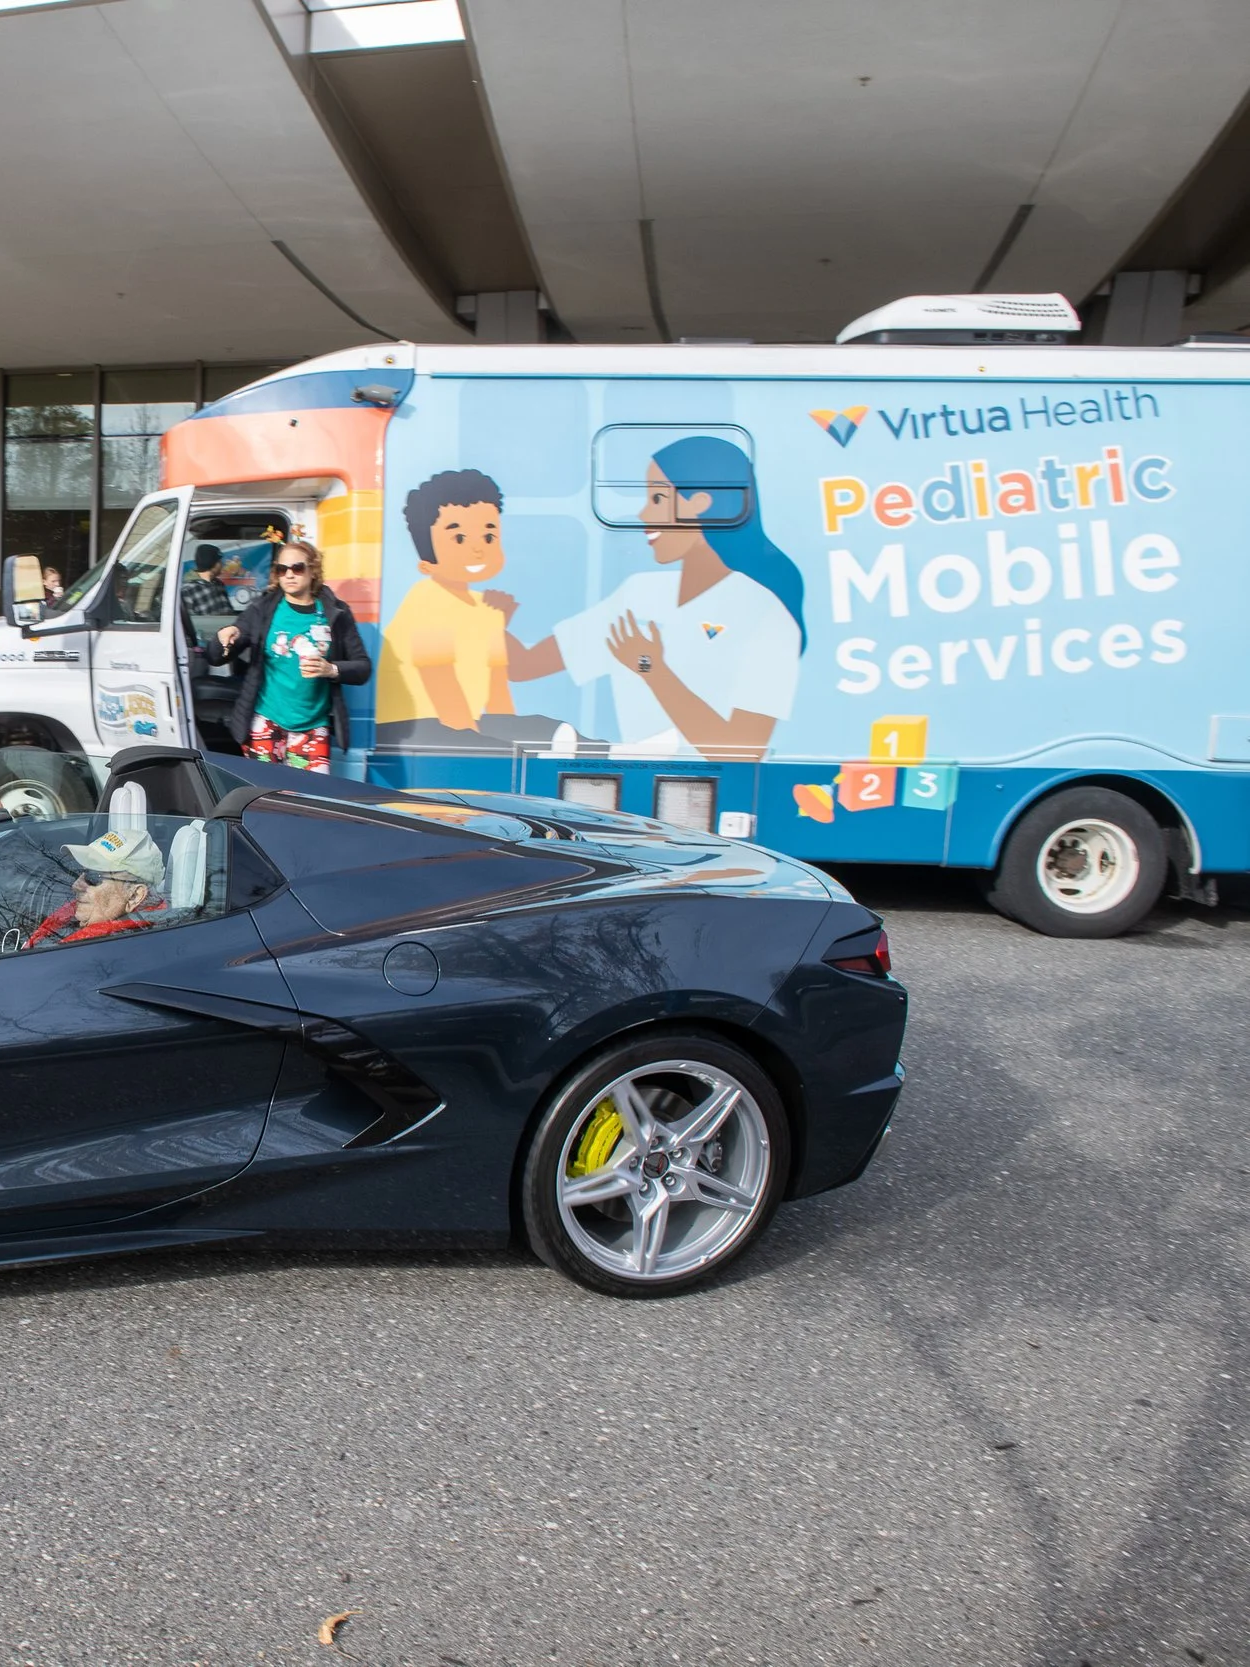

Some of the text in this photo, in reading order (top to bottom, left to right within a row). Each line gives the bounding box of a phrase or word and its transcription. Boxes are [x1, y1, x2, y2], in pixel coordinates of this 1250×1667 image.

[878, 387, 1160, 440] Virtua Health
[819, 444, 1177, 534] Pediatric
[828, 519, 1181, 623] Mobile
[835, 618, 1187, 694] Services
[882, 730, 898, 758] 1
[860, 774, 881, 801] 2
[913, 772, 938, 798] 3
